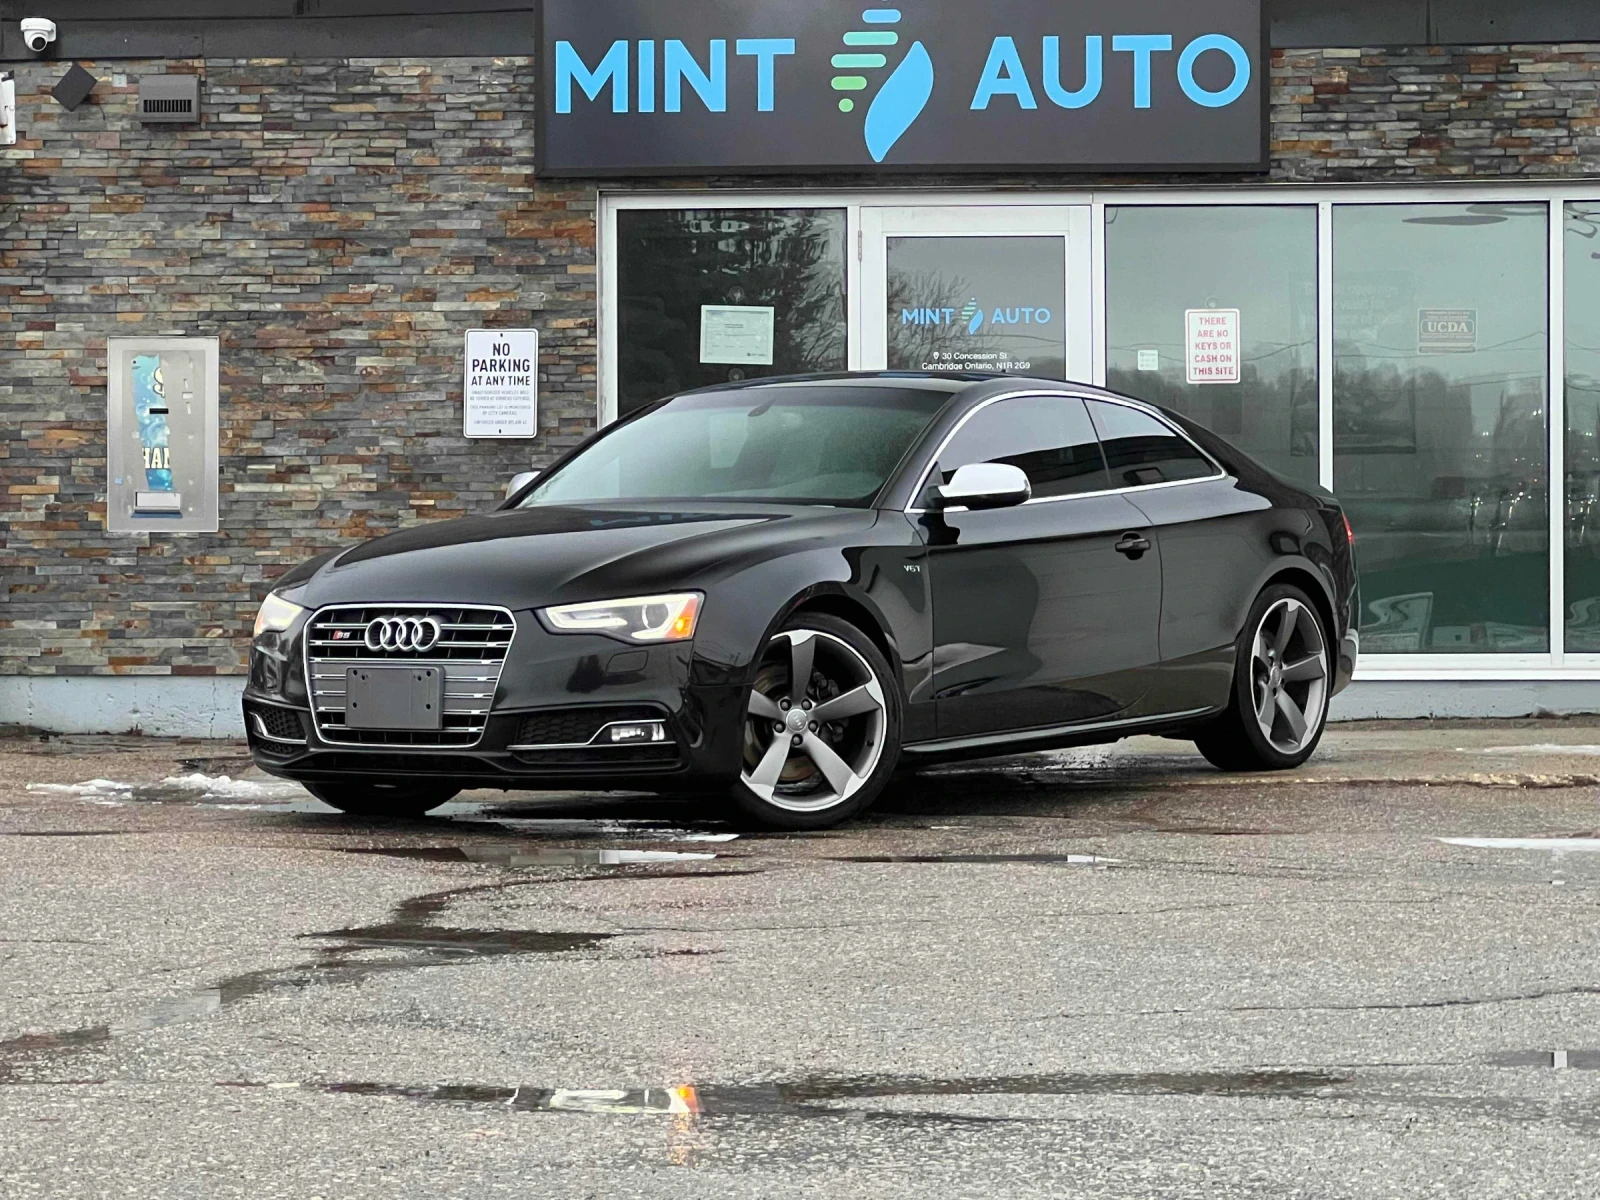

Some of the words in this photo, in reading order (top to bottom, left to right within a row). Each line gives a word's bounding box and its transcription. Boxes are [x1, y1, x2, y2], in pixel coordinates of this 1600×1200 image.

[555, 38, 796, 114] MINT
[969, 33, 1251, 110] AUTO
[902, 308, 955, 325] MINT
[991, 307, 1051, 324] AUTO
[1198, 317, 1227, 325] THERE
[1427, 321, 1469, 333] UCDA
[1197, 329, 1214, 337] ARE
[1216, 329, 1229, 337] NO
[492, 342, 510, 356] NO
[1195, 342, 1218, 350] KEYS
[941, 352, 952, 360] 30
[954, 352, 997, 360] Concession
[1194, 355, 1218, 363] CASH
[1219, 354, 1232, 362] ON
[472, 358, 531, 372] PARKING
[922, 362, 963, 371] Cambridge
[964, 362, 994, 370] Ontario,
[996, 361, 1013, 369] N1R
[1014, 361, 1031, 370] 2G9
[1193, 367, 1213, 375] THIS
[1215, 367, 1234, 375] SITE
[471, 376, 482, 386] AT
[485, 376, 505, 386] ANY
[508, 375, 531, 386] TIME
